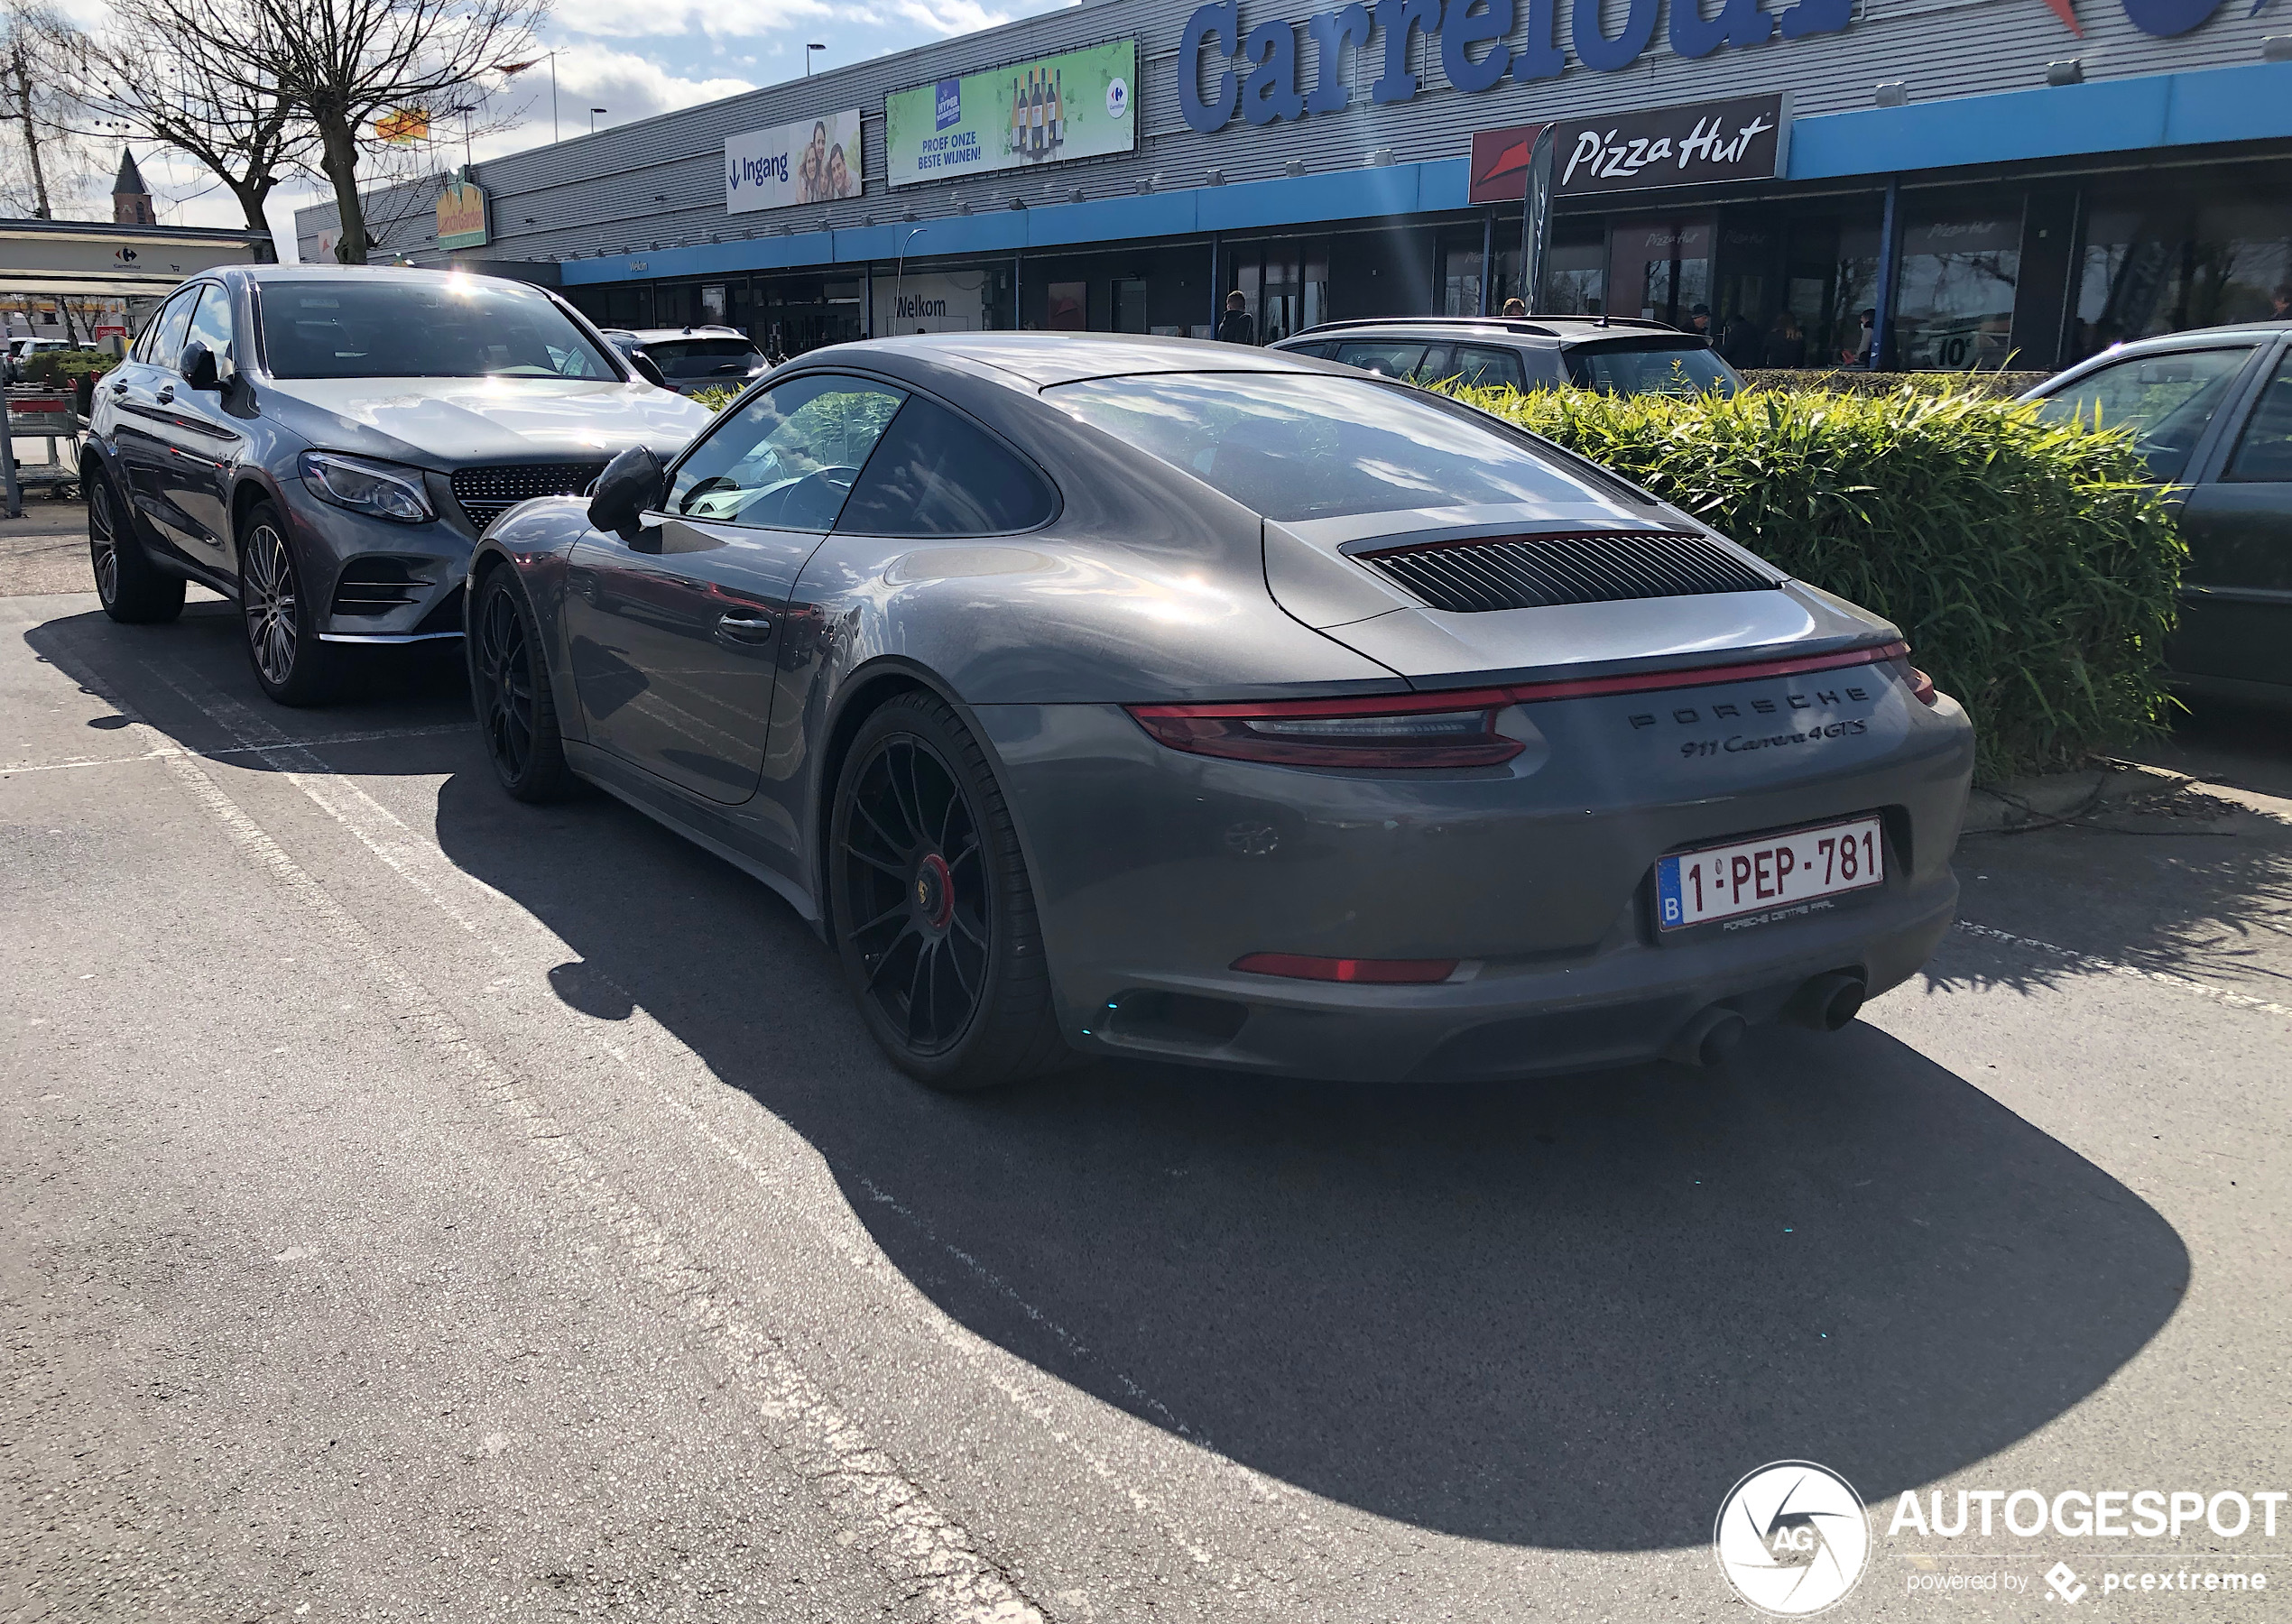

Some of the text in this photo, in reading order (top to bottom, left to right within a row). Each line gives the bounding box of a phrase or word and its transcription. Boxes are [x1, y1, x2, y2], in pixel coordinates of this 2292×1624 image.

[938, 95, 958, 114] HYPER
[923, 131, 976, 153] PROEF ONZE
[1562, 116, 1774, 186] Pizza Hut
[919, 146, 981, 170] BESTE WIJNEN!
[743, 152, 789, 187] Ingang
[1645, 231, 1700, 247] Pizza Hut
[629, 261, 647, 272] Welkom
[894, 294, 946, 318] Welkom
[1628, 687, 1870, 730] PORSCHE
[1680, 740, 1718, 759] 911
[1688, 831, 1875, 913] 1-PEP-781
[1665, 898, 1679, 920] B
[1723, 914, 1769, 931] PORSCHE
